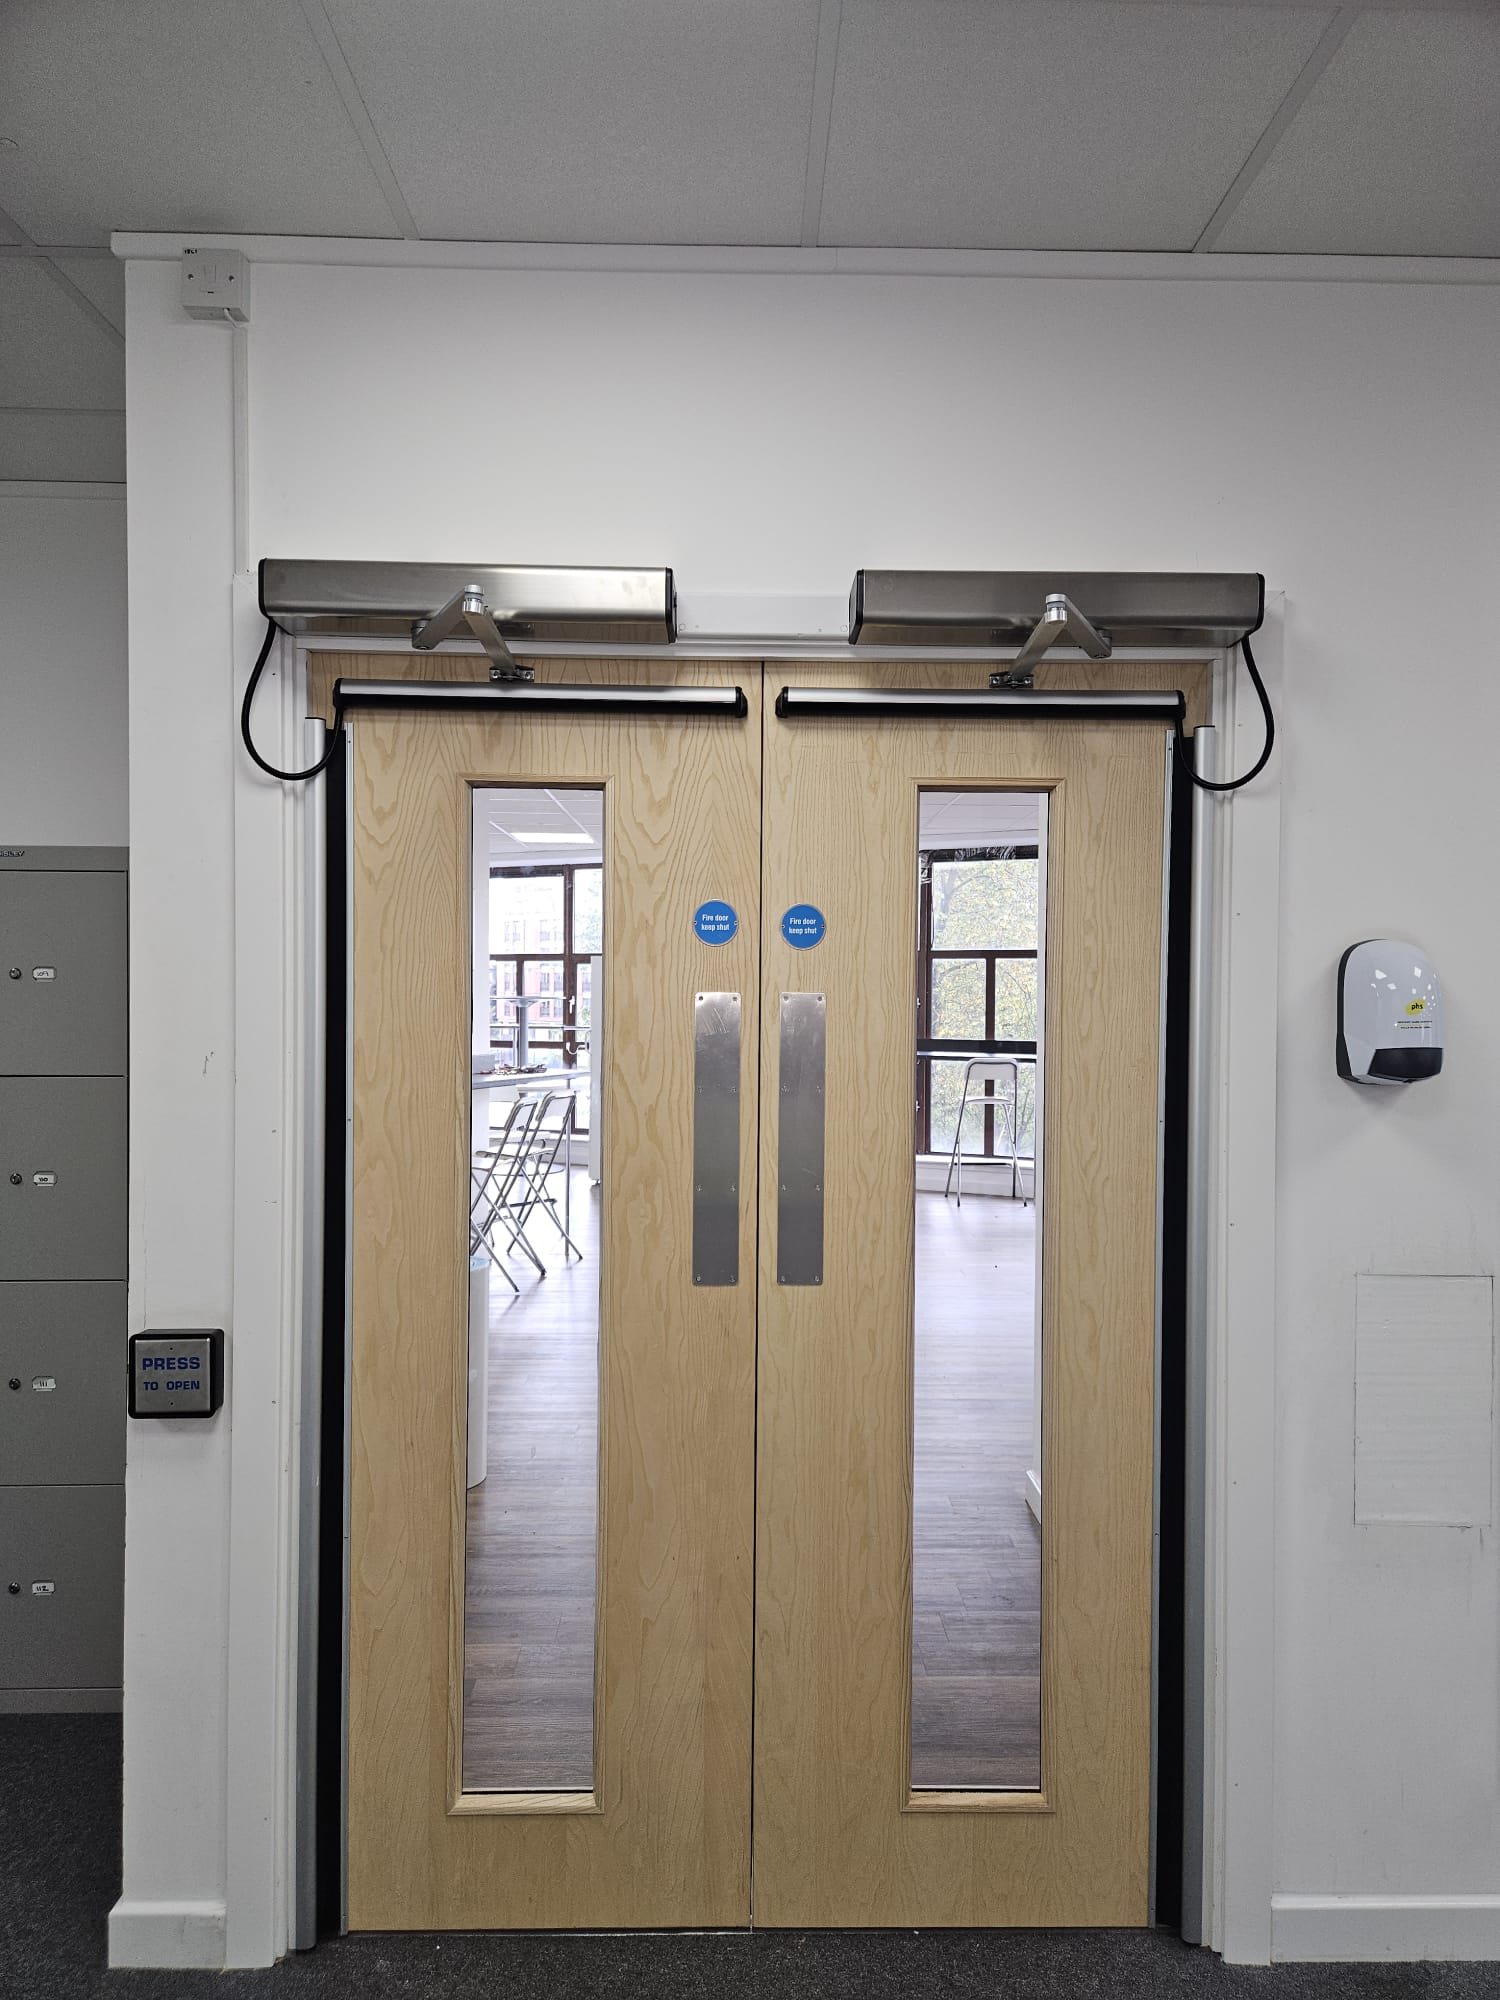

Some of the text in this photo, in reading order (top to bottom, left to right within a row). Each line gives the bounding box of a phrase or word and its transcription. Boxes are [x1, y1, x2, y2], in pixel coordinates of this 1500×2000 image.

[790, 917, 816, 925] Fire door
[701, 923, 716, 931] keep
[788, 926, 803, 935] keep
[1411, 1002, 1424, 1010] phs
[142, 1356, 201, 1371] PRESS
[143, 1380, 201, 1391] TO OPEN
